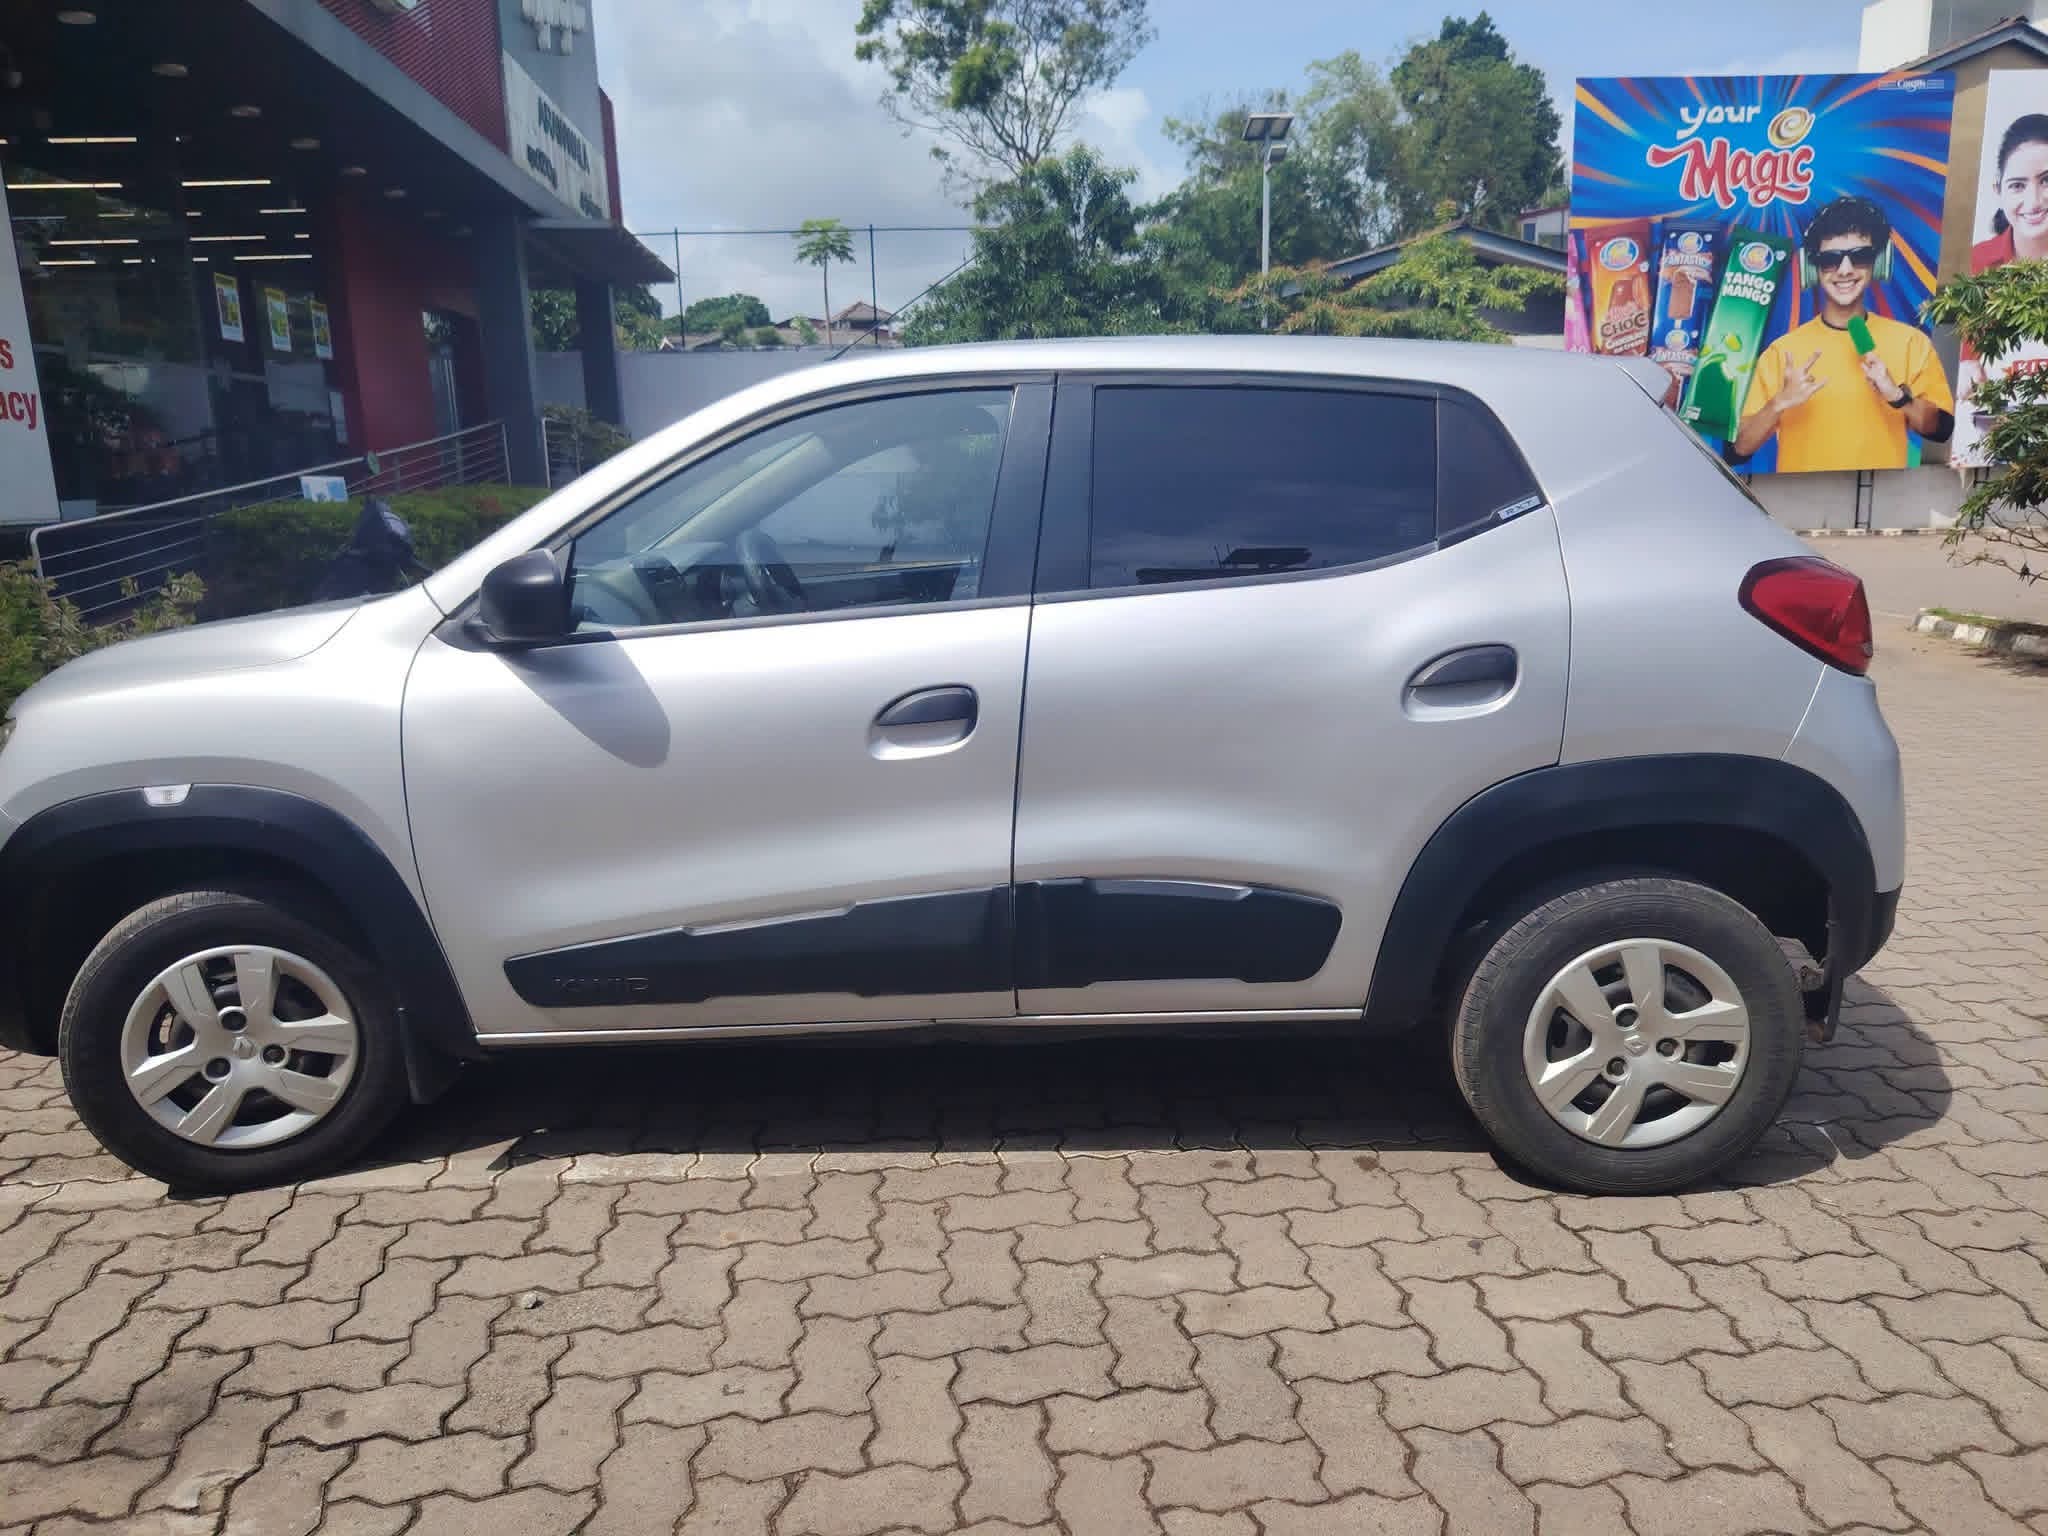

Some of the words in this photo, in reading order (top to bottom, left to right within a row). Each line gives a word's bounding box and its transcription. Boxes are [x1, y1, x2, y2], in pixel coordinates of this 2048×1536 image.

[1676, 105, 1761, 140] your
[1646, 136, 1815, 209] Magic
[1725, 271, 1775, 293] TANGO
[1722, 285, 1771, 306] MANGO
[1600, 312, 1648, 337] CHOC
